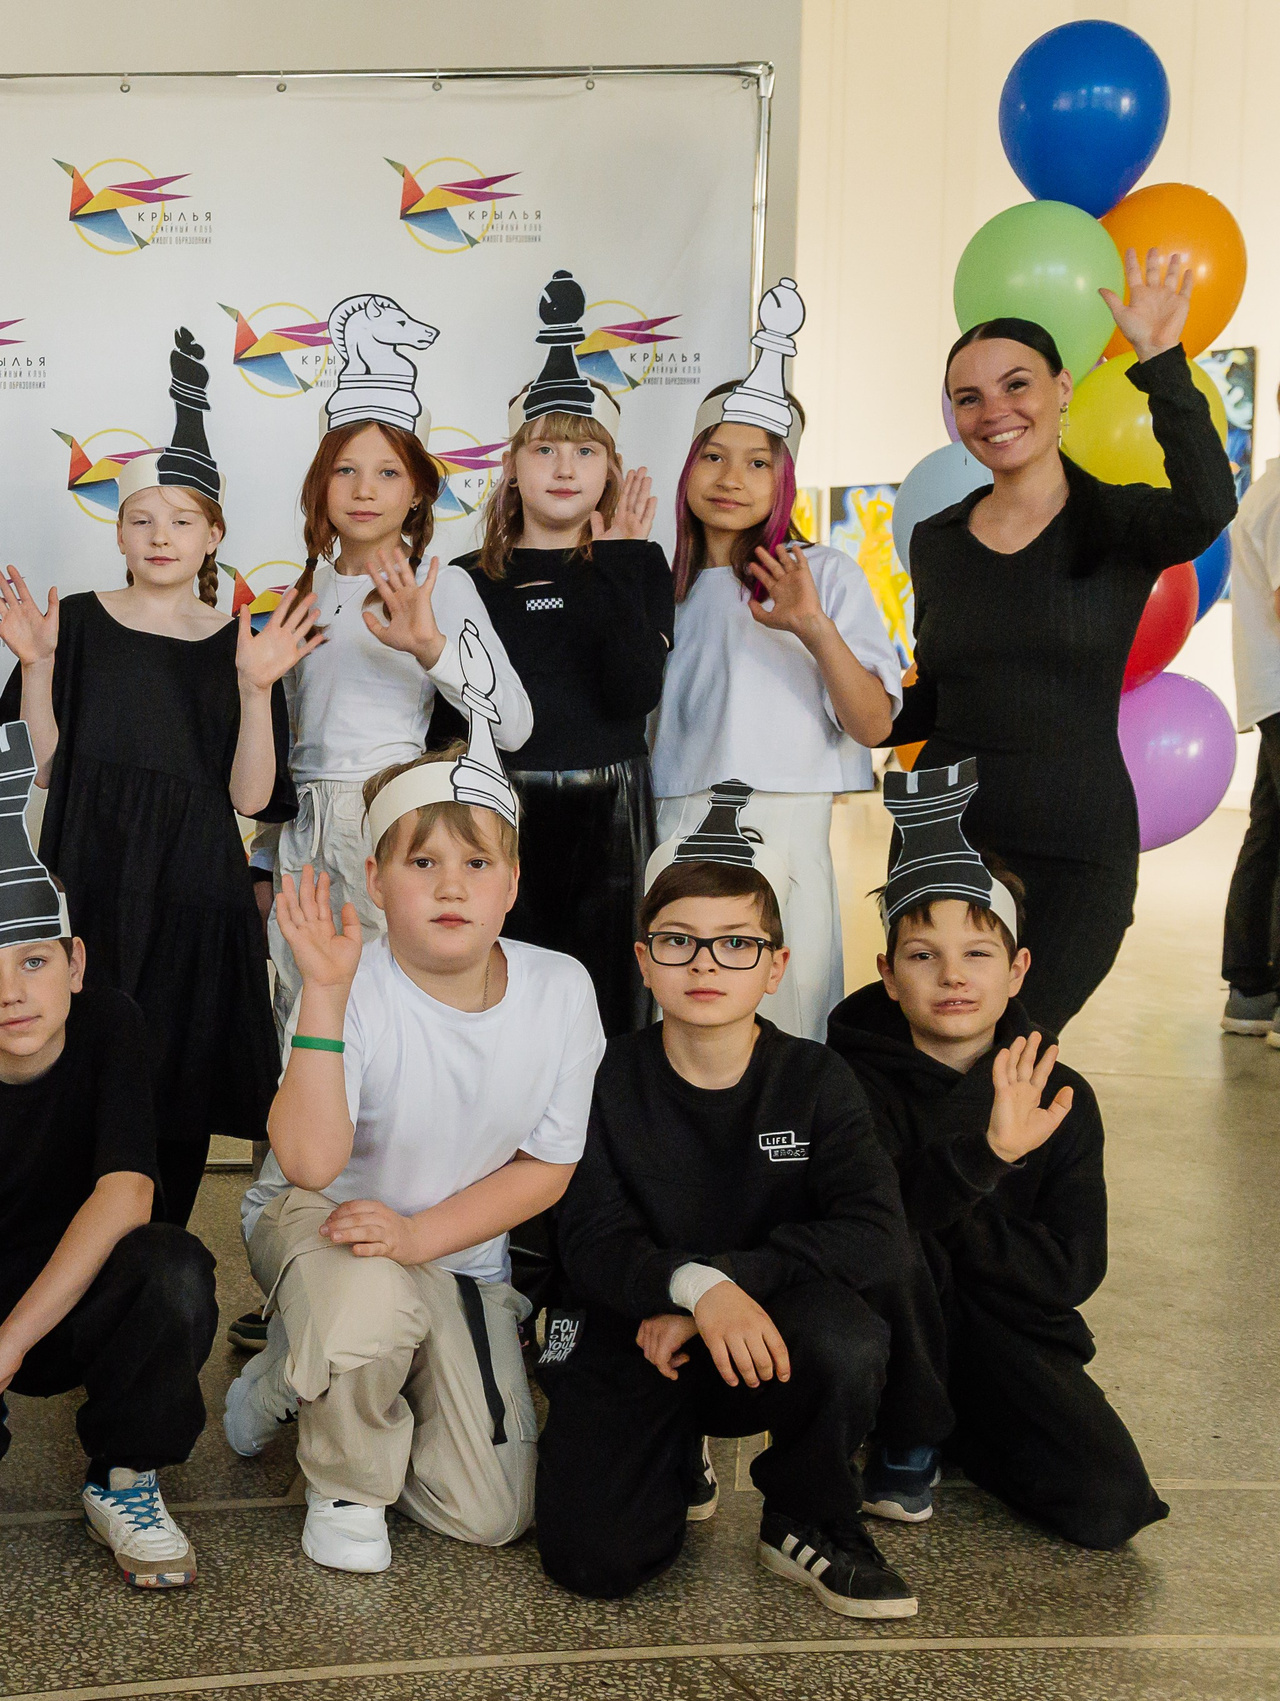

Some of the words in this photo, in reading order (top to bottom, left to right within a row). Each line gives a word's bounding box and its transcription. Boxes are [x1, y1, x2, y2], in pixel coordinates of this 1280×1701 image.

[138, 212, 211, 221] КРЫЛЬЯ
[468, 210, 541, 220] КРЫЛЬЯ
[302, 356, 341, 365] КРЫ
[630, 353, 700, 362] КРЫЛЬЯ
[766, 1136, 787, 1145] LIFE
